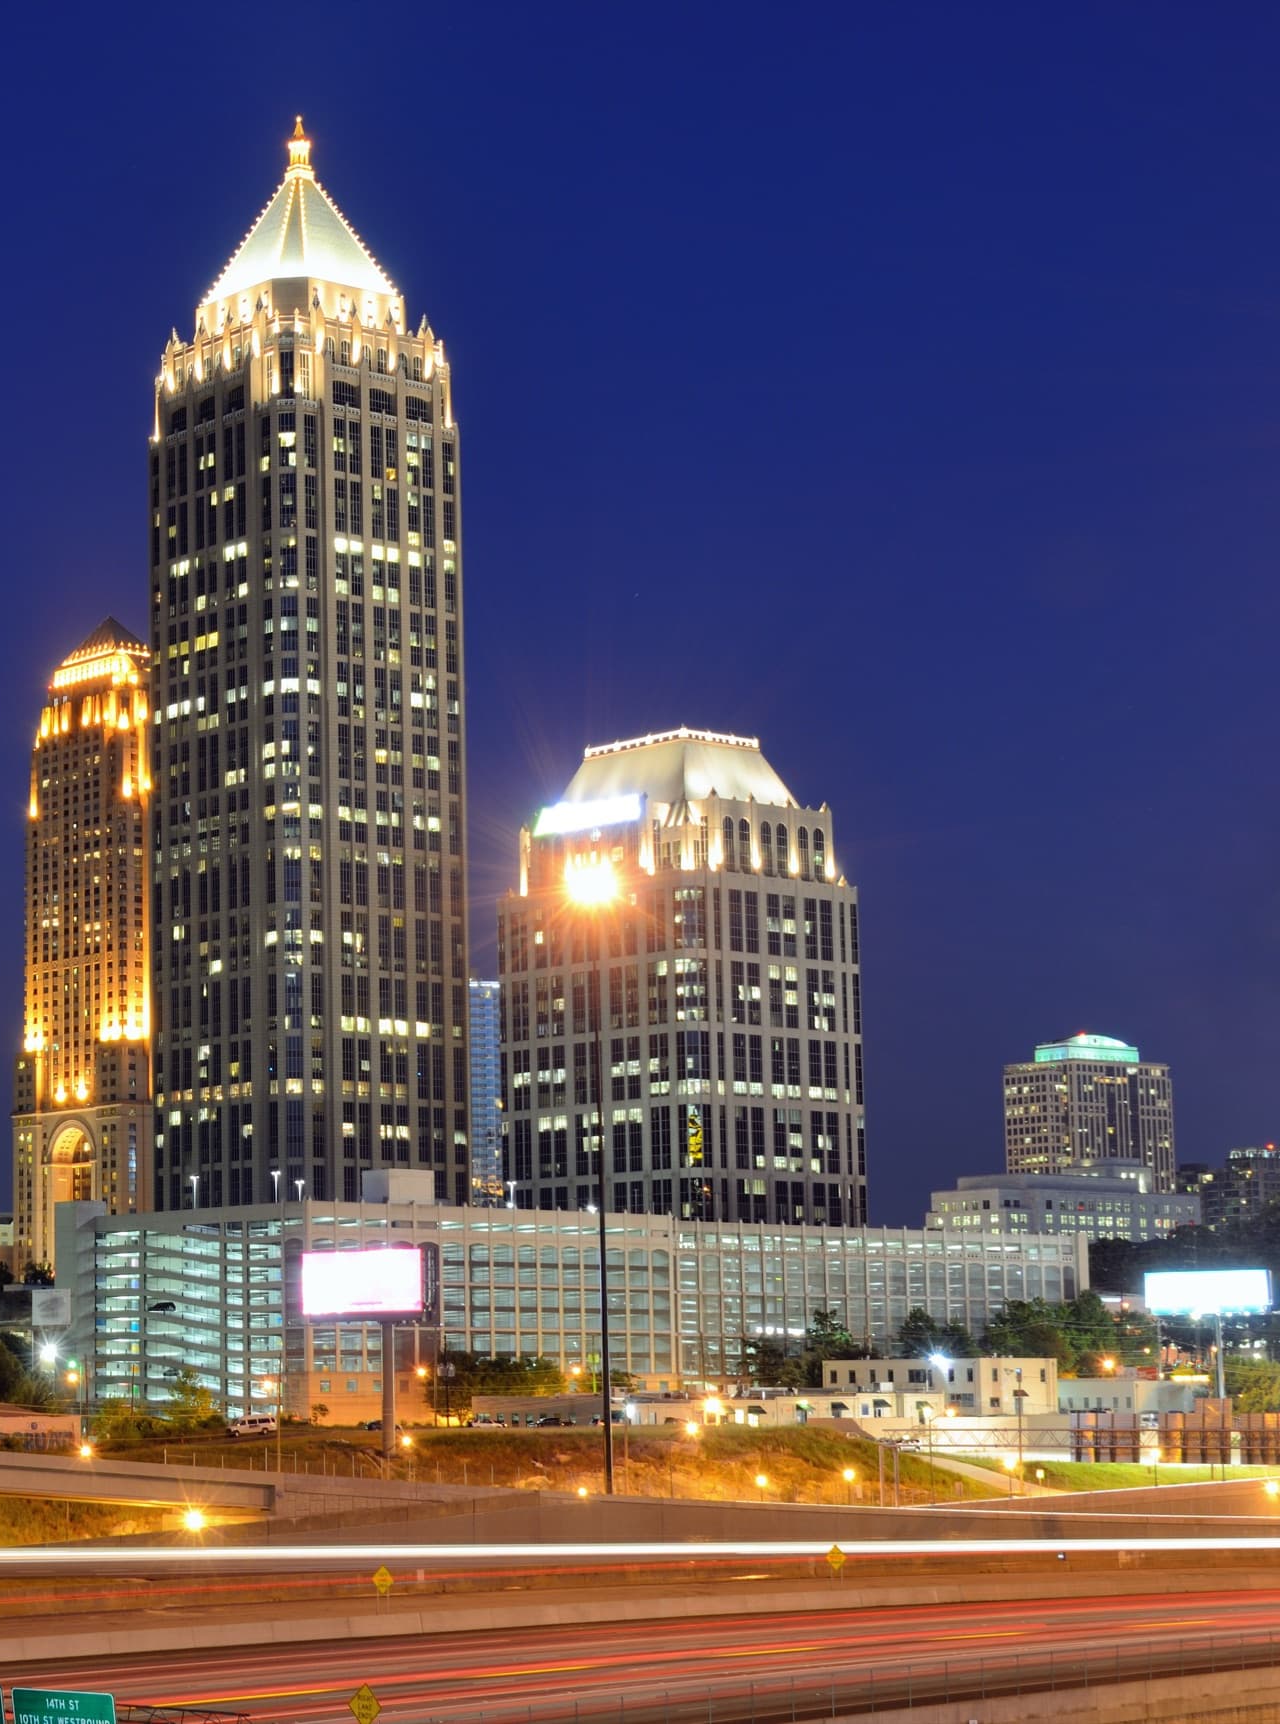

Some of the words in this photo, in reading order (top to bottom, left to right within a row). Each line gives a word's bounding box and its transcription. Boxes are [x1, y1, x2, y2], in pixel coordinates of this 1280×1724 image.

[46, 1698, 66, 1710] 14TH
[69, 1699, 80, 1711] ST
[19, 1713, 40, 1724] 10TH
[43, 1715, 54, 1724] ST
